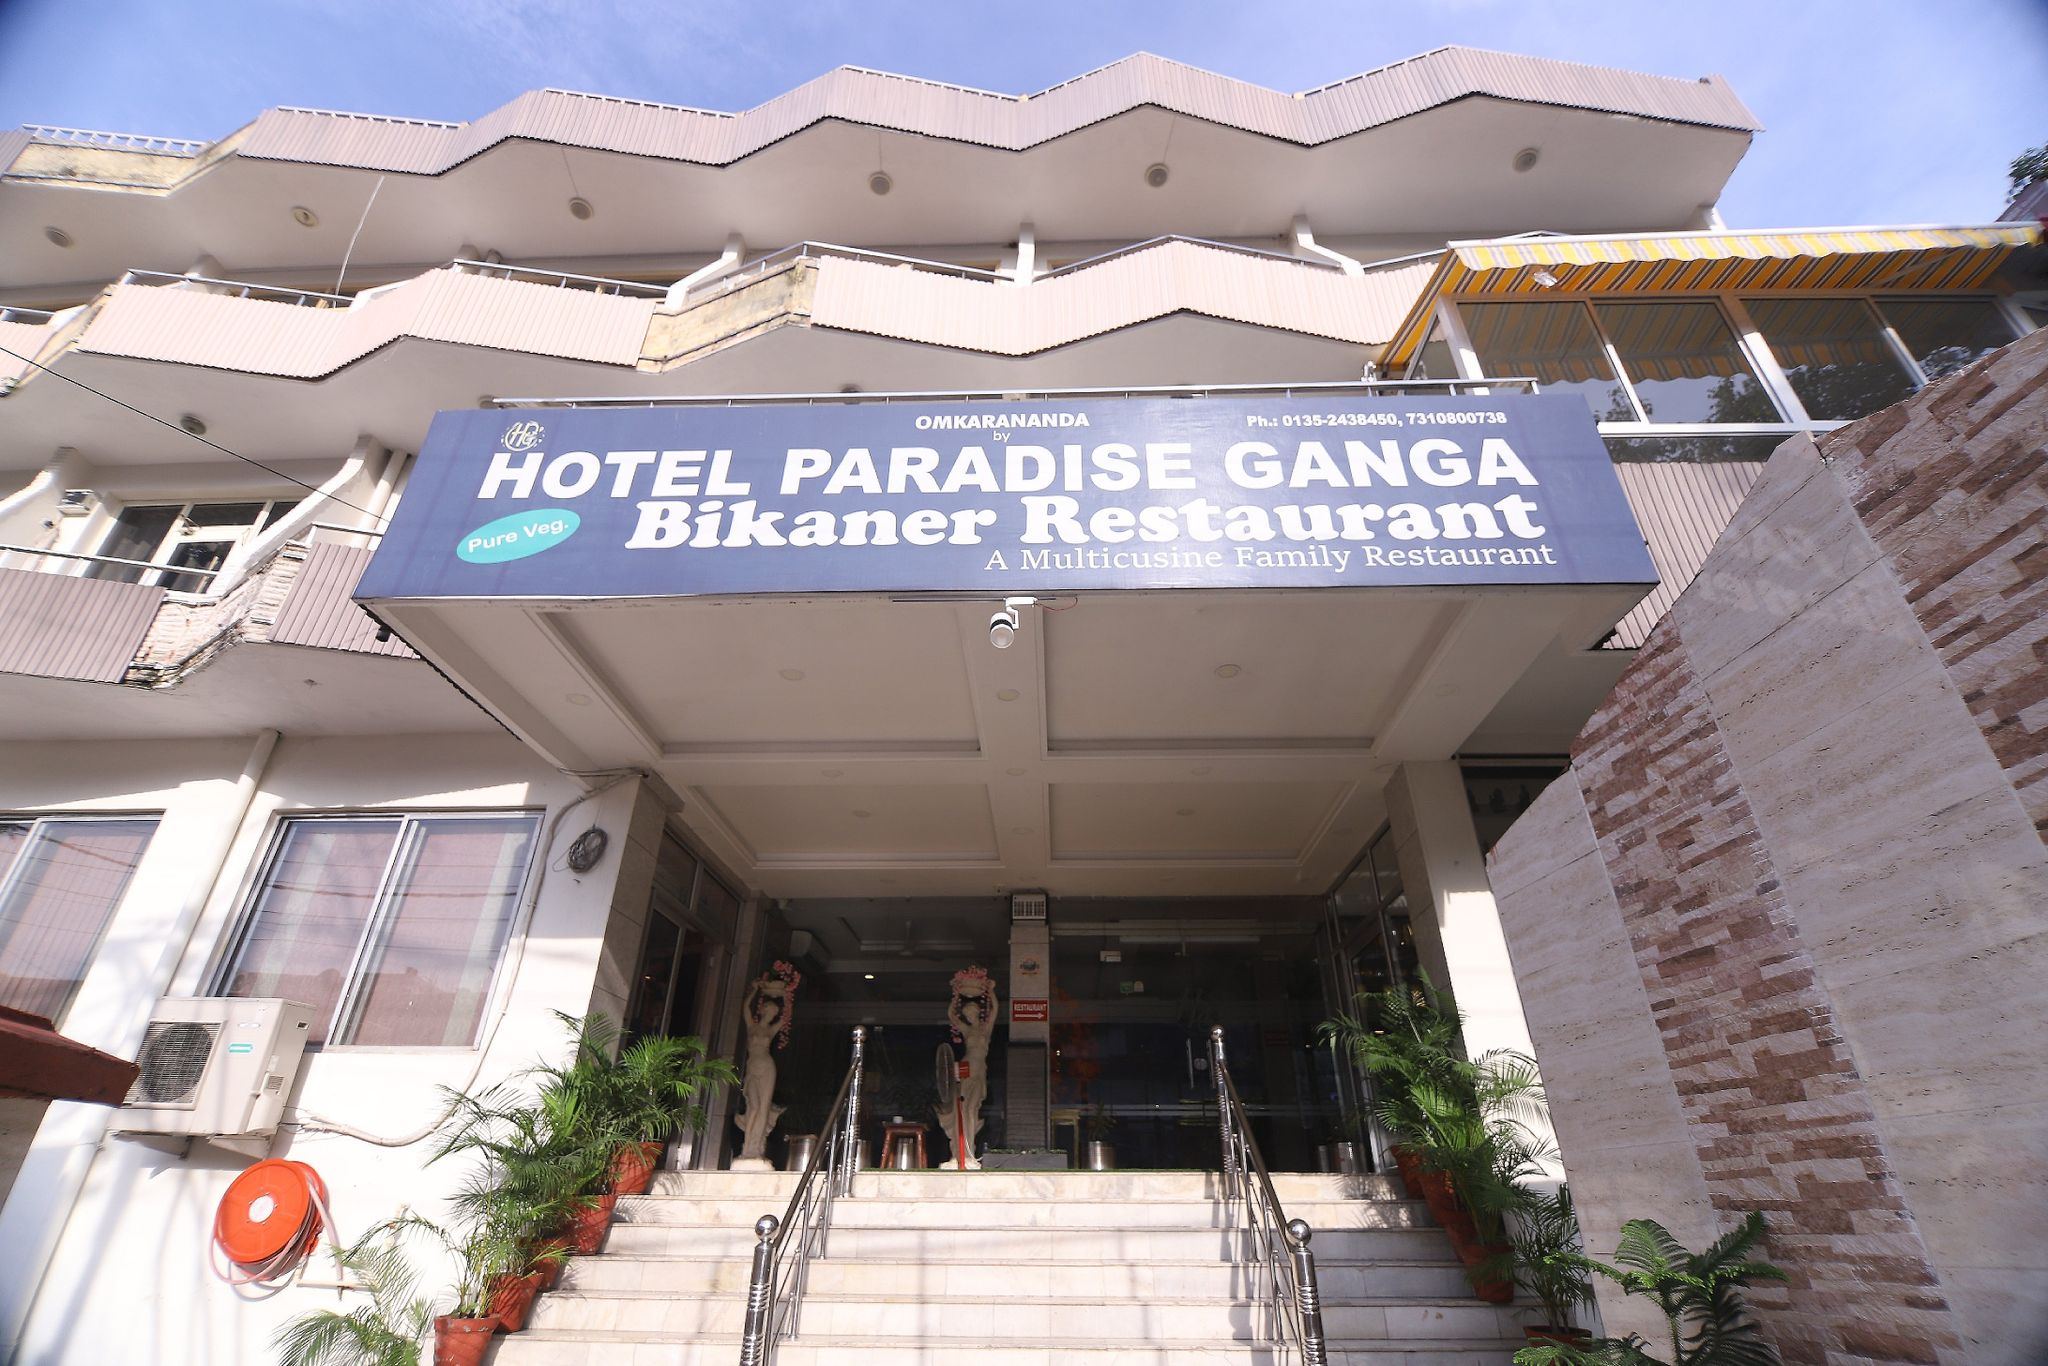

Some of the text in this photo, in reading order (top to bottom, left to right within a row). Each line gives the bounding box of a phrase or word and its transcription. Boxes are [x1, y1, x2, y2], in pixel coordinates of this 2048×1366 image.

[915, 413, 1090, 430] OMKARANANDA
[1246, 411, 1507, 428] Ph.: 0135-2438450, 7310800738
[992, 431, 1010, 443] by
[477, 438, 1539, 499] HOTEL PARADISE GANGA
[468, 519, 569, 553] Pure Veg.
[624, 494, 1546, 549] Bikaner Restaurant
[984, 544, 1557, 573] A Multicusine Family Restaurant
